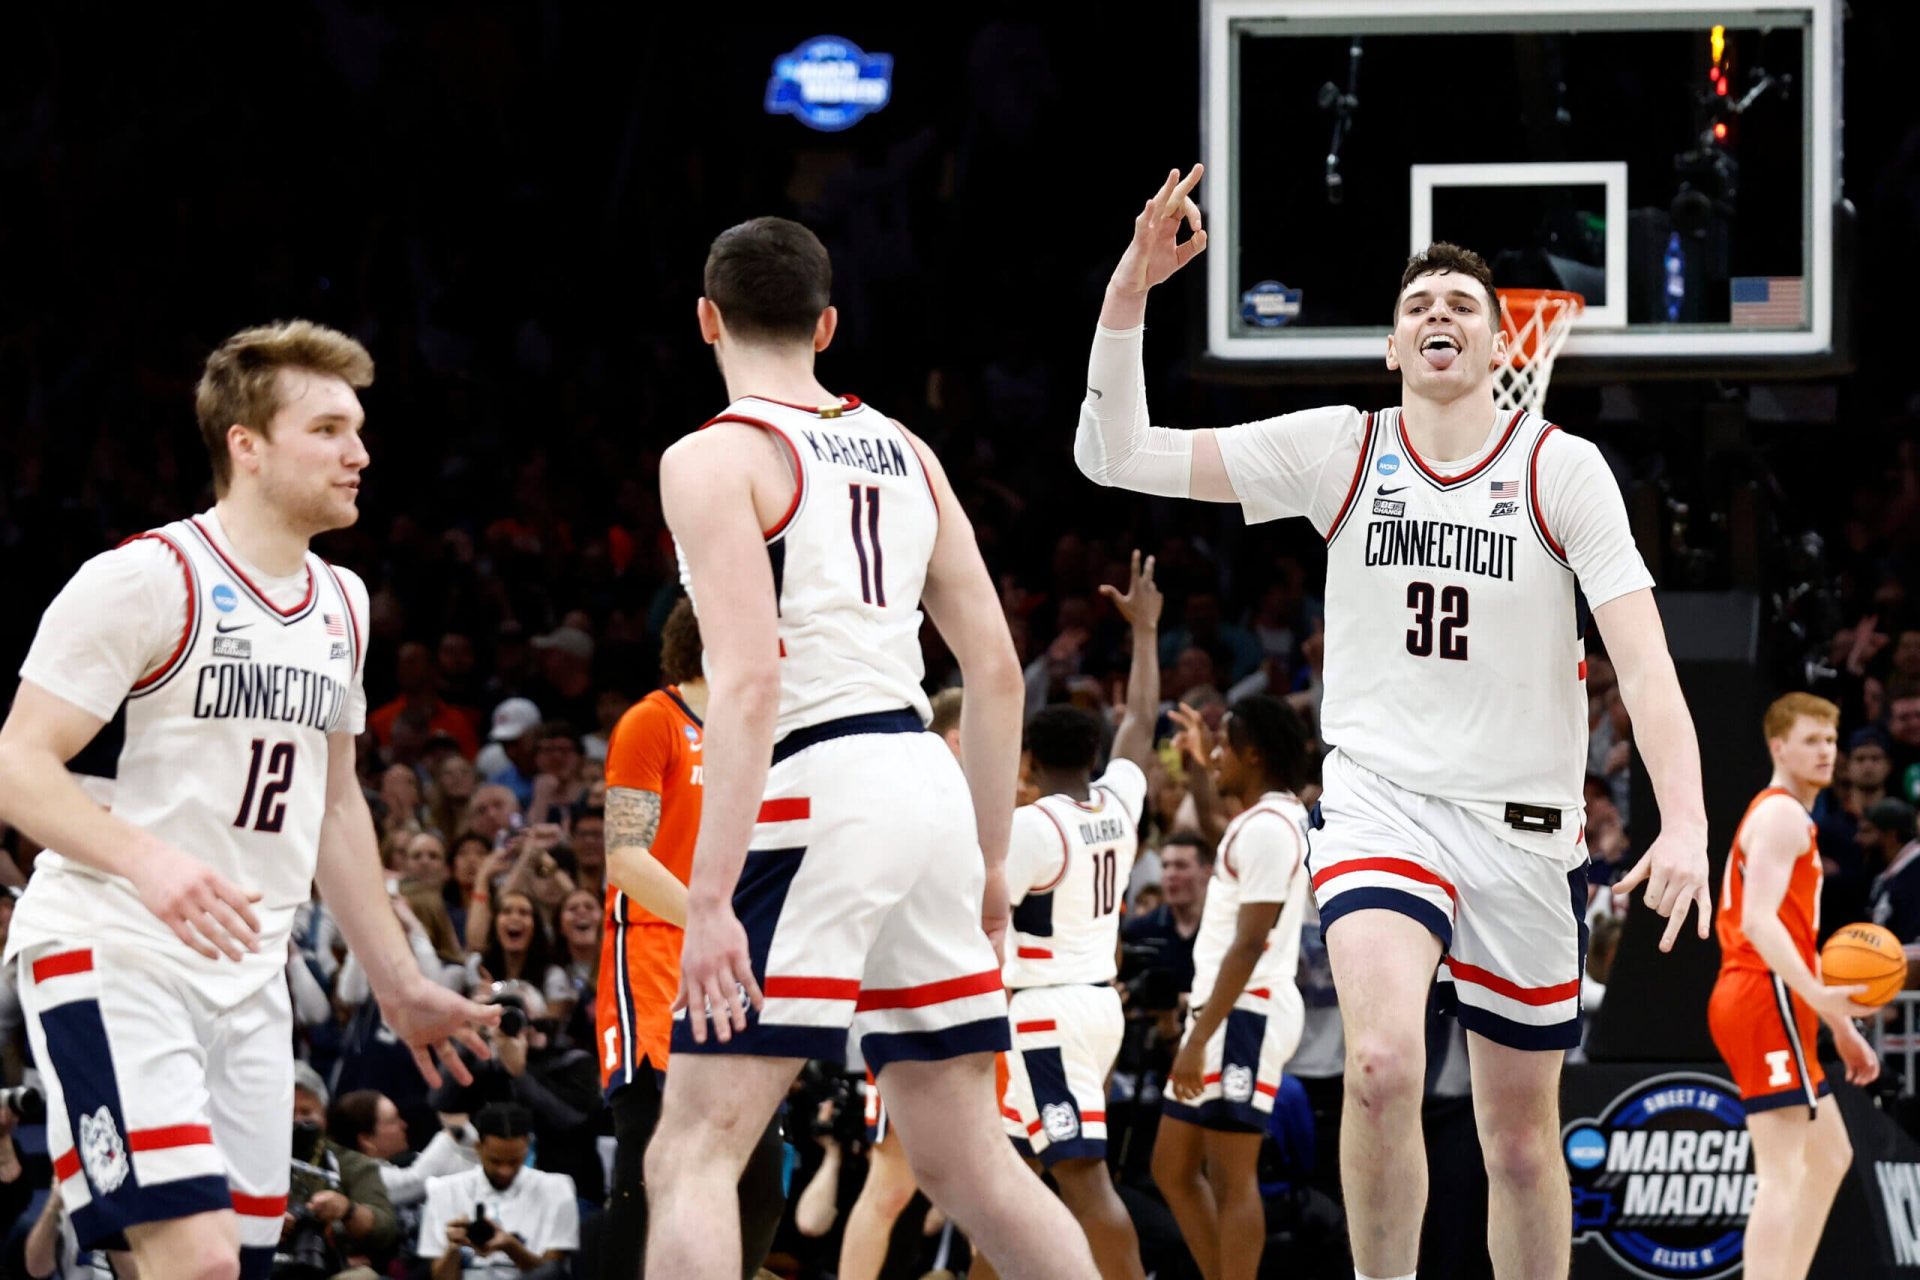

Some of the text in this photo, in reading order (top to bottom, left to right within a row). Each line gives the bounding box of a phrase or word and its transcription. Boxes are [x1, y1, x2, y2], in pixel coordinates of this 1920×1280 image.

[801, 430, 908, 476] KARABAN
[1491, 507, 1520, 515] EAST
[849, 483, 887, 607] 11
[1365, 520, 1517, 582] CONNECTICUT
[1406, 581, 1469, 661] 32
[233, 738, 297, 833] 12
[1092, 848, 1116, 919] 10
[1765, 1050, 1792, 1087] I
[1643, 1089, 1719, 1115] SWEET 16
[1606, 1130, 1750, 1172] MARCH
[1623, 1174, 1757, 1216] MADNE
[1652, 1247, 1698, 1269] ELITE
